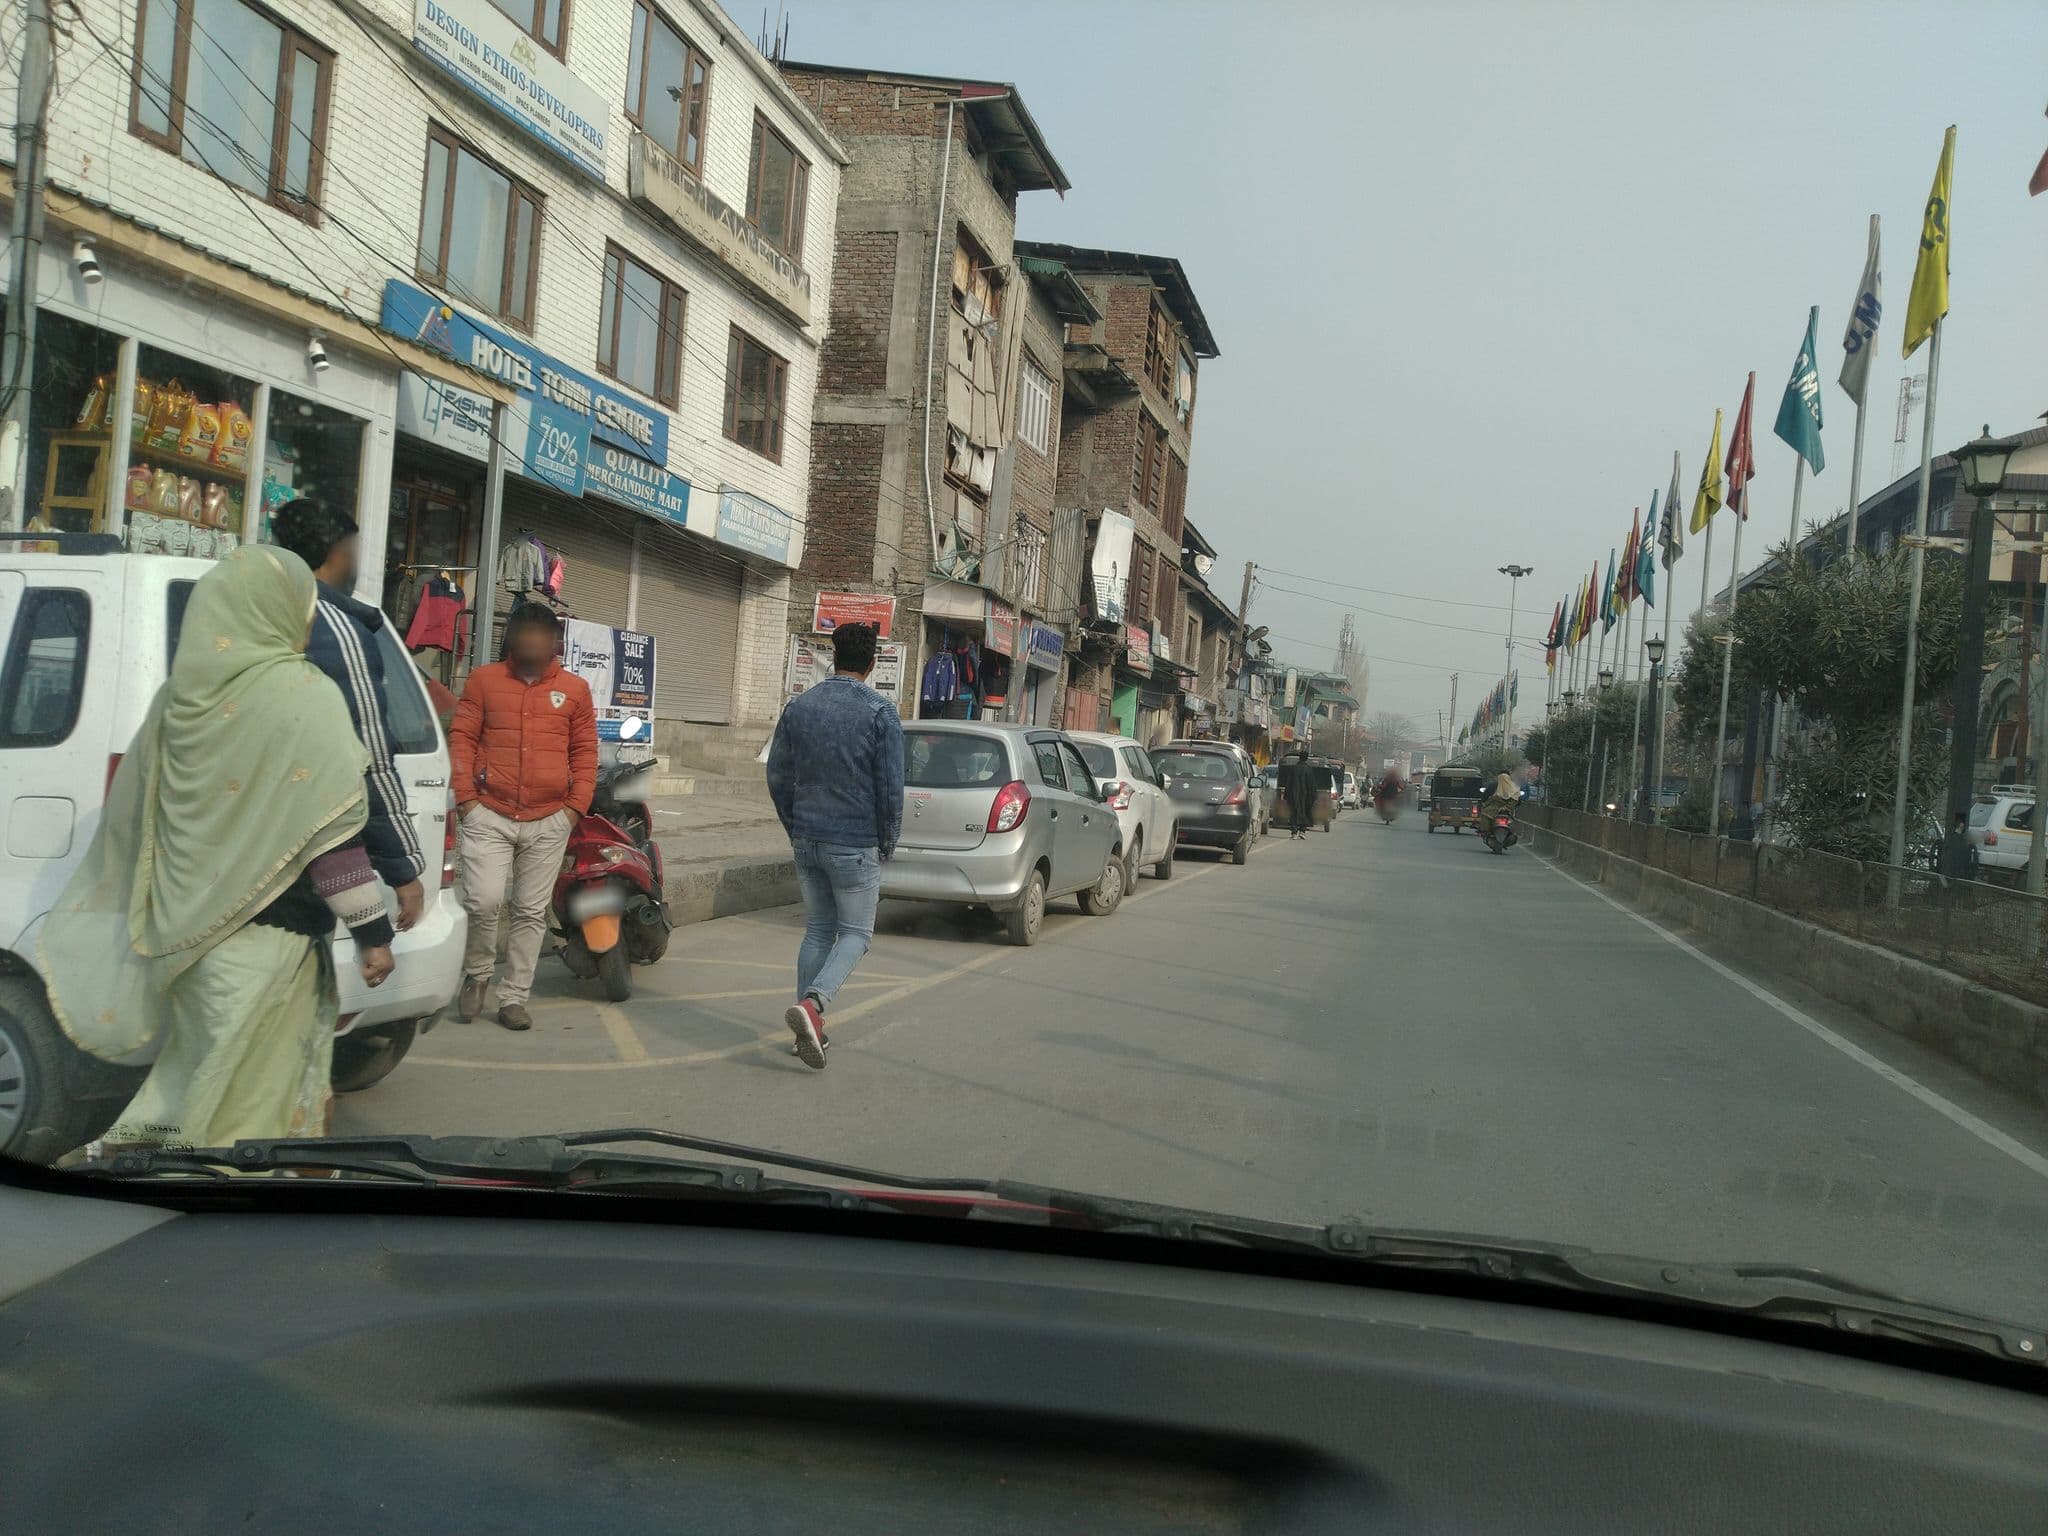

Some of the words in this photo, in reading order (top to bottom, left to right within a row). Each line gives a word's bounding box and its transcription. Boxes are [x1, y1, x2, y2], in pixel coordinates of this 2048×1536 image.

[417, 22, 449, 52] ARCHITECTS
[426, 0, 480, 56] DESIGN
[471, 334, 536, 392] HOTEL
[540, 367, 593, 417] TOWN
[595, 394, 655, 447] CENTRE
[538, 422, 578, 467] 70%
[605, 448, 672, 490] QUALITY
[586, 463, 656, 502] MERCHANDISE
[657, 491, 683, 512] MART
[620, 631, 649, 646] CLEARANCE
[624, 642, 645, 659] SALE
[580, 660, 608, 670] FIESTA
[581, 651, 611, 662] FASHION
[623, 665, 644, 684] 70%
